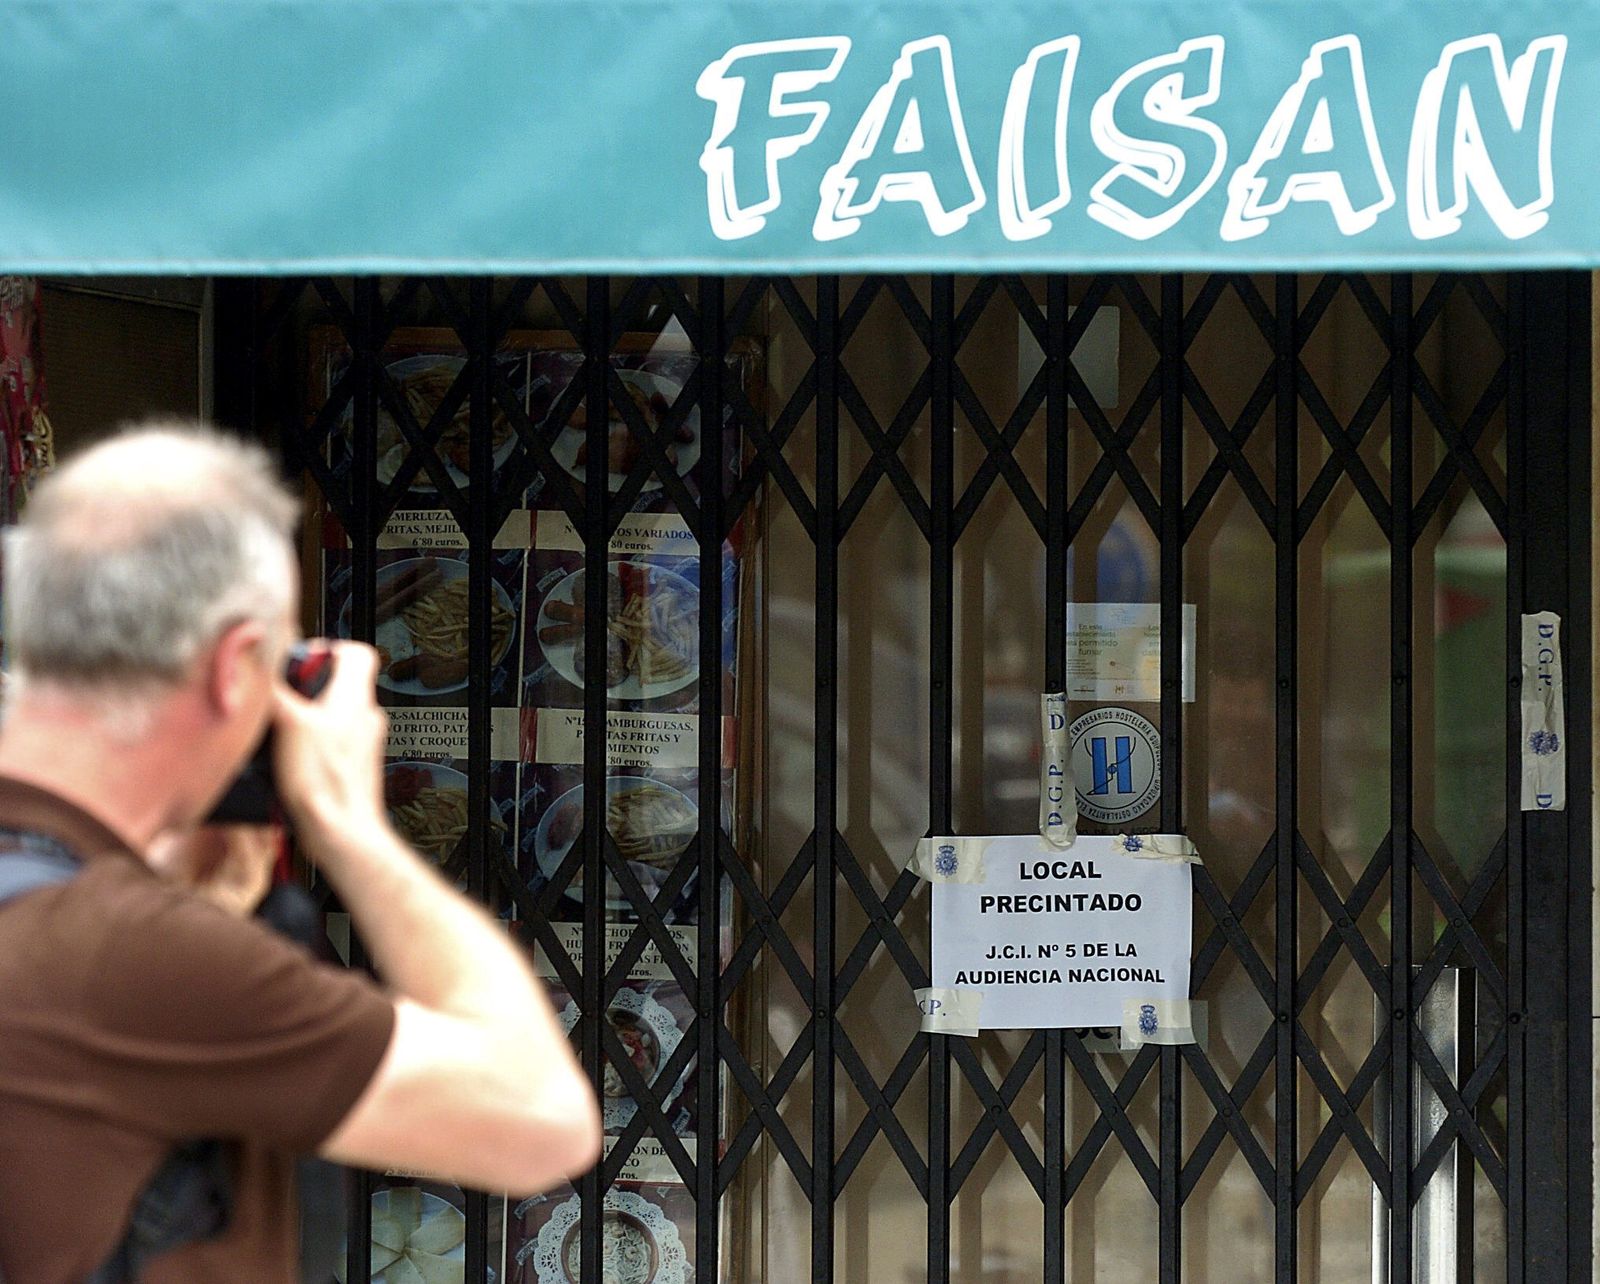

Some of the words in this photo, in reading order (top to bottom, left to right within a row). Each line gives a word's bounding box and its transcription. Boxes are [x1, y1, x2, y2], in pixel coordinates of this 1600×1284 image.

[696, 33, 1567, 242] FAISAN
[385, 525, 422, 534] RITAS,
[426, 525, 463, 533] MEJIL
[634, 528, 693, 540] VARIADOS
[435, 538, 463, 546] euros.
[624, 542, 654, 550] euros.
[404, 724, 441, 735] FRITO,
[606, 718, 694, 732] AMBURGUESAS,
[1071, 711, 1113, 736] EMPRESARIOS
[410, 737, 417, 746] Y
[419, 737, 469, 748] CROQUE
[630, 732, 671, 743] FRITAS
[673, 734, 681, 743] Y
[607, 743, 660, 755] MIENTOS
[1019, 861, 1102, 880] LOCAL
[980, 893, 1142, 913] PRECINTADO
[985, 944, 1031, 960] J.C.I.
[1065, 944, 1076, 958] 5
[1083, 943, 1108, 958] DE
[1115, 943, 1137, 957] LA
[630, 969, 653, 977] uros.
[954, 969, 1062, 985] AUDIENCIA
[1068, 968, 1165, 984] NACIONAL
